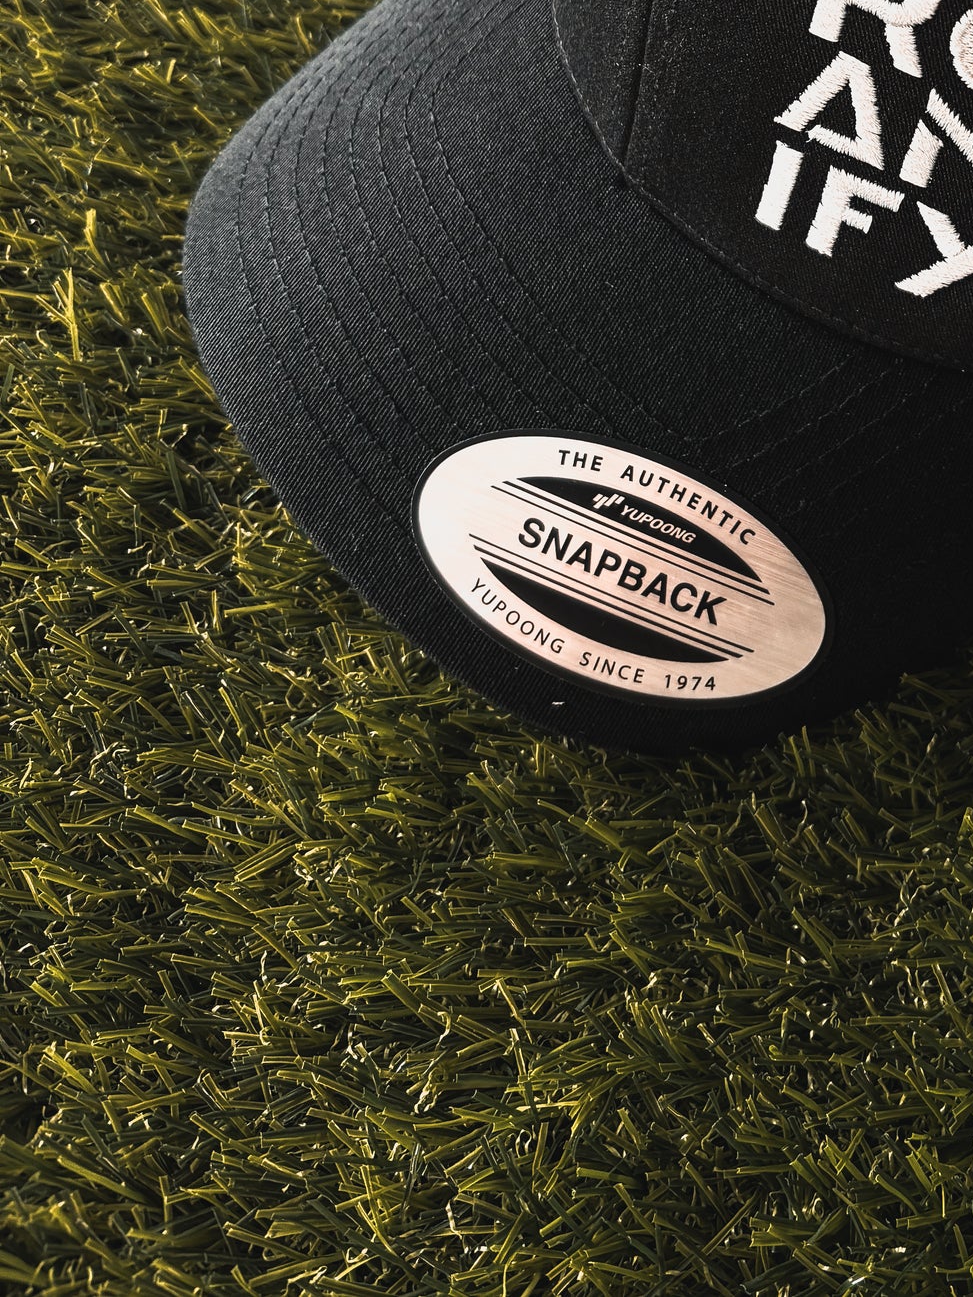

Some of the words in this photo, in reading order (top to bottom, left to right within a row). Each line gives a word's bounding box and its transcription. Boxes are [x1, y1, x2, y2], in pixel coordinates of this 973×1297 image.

[558, 449, 604, 471] THE
[620, 465, 757, 546] AUTHENTIC
[619, 504, 697, 544] YUPOONG
[517, 517, 729, 626] SNAPBACK
[470, 577, 566, 654] YUPOONG
[579, 651, 645, 684] SINCE
[664, 674, 717, 692] 1974
